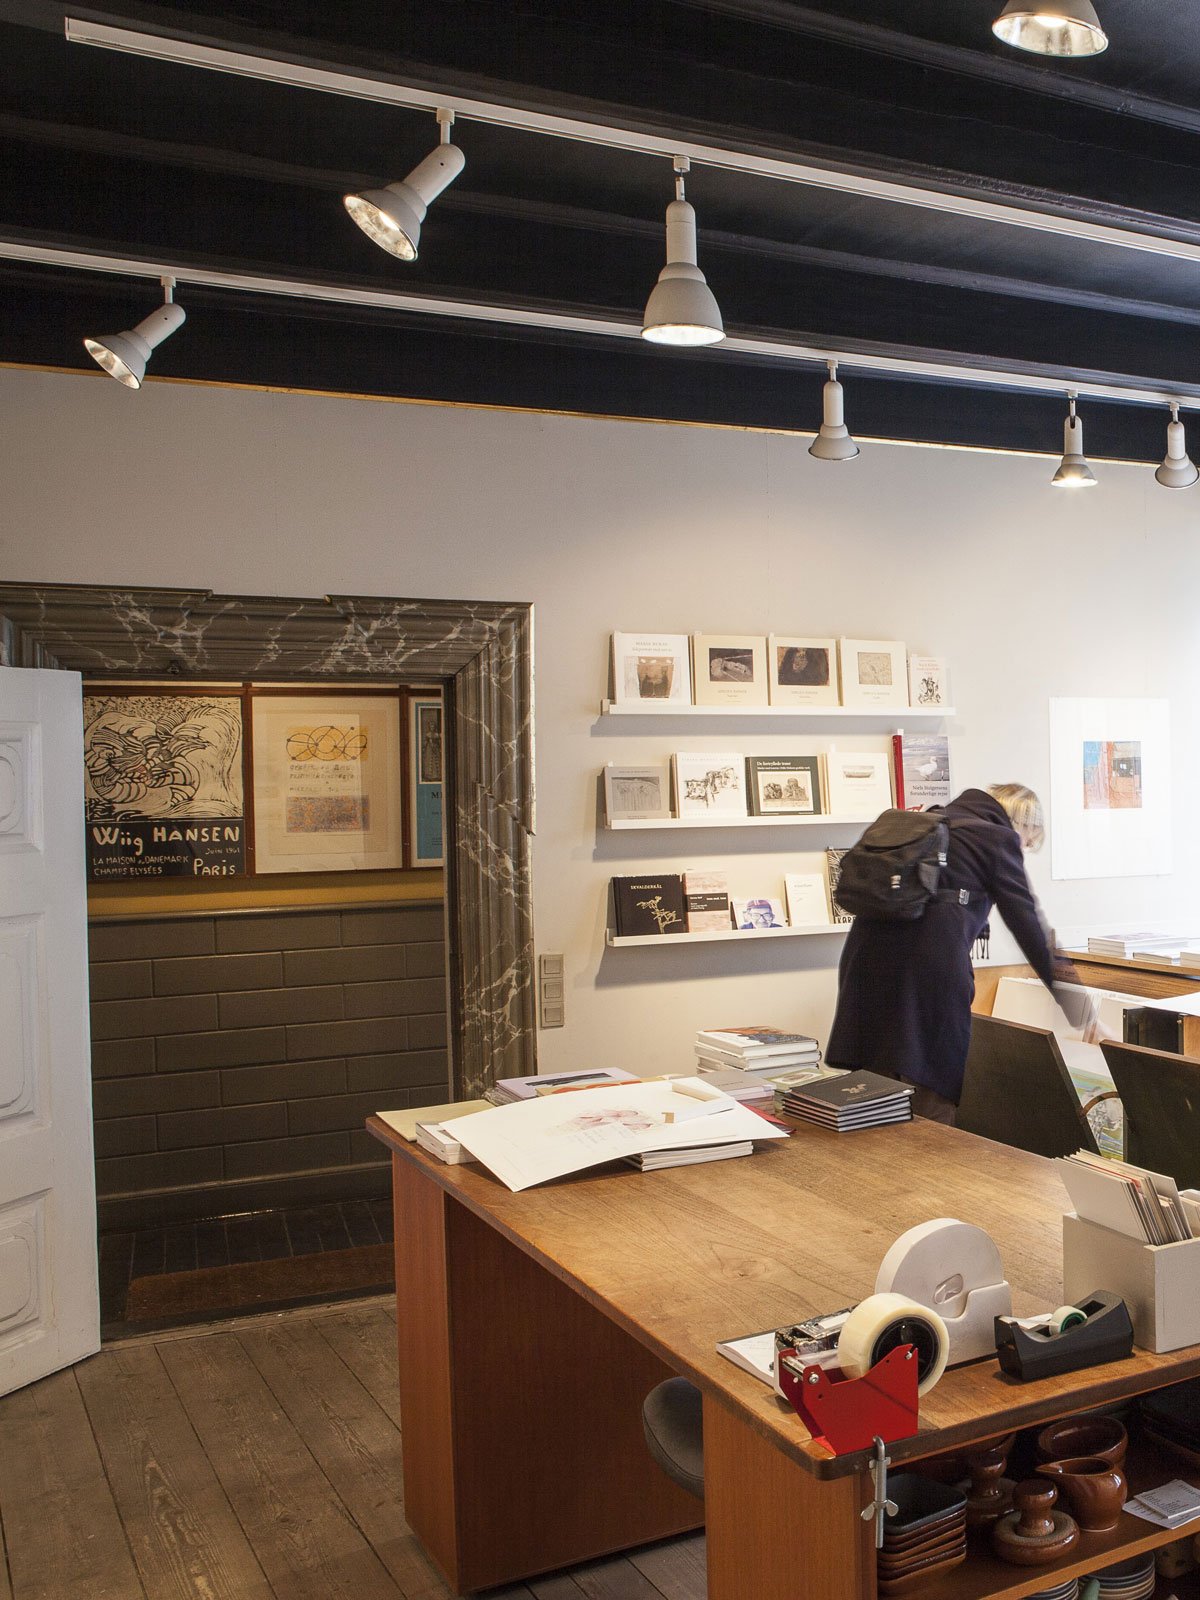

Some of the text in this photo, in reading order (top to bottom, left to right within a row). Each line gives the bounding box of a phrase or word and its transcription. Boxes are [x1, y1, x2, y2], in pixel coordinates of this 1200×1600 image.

[93, 826, 239, 856] Wiig HANSEN
[93, 857, 103, 865] LA
[106, 856, 136, 865] MAISON
[145, 855, 189, 864] DANEMARK
[94, 867, 127, 876] CHAMPS
